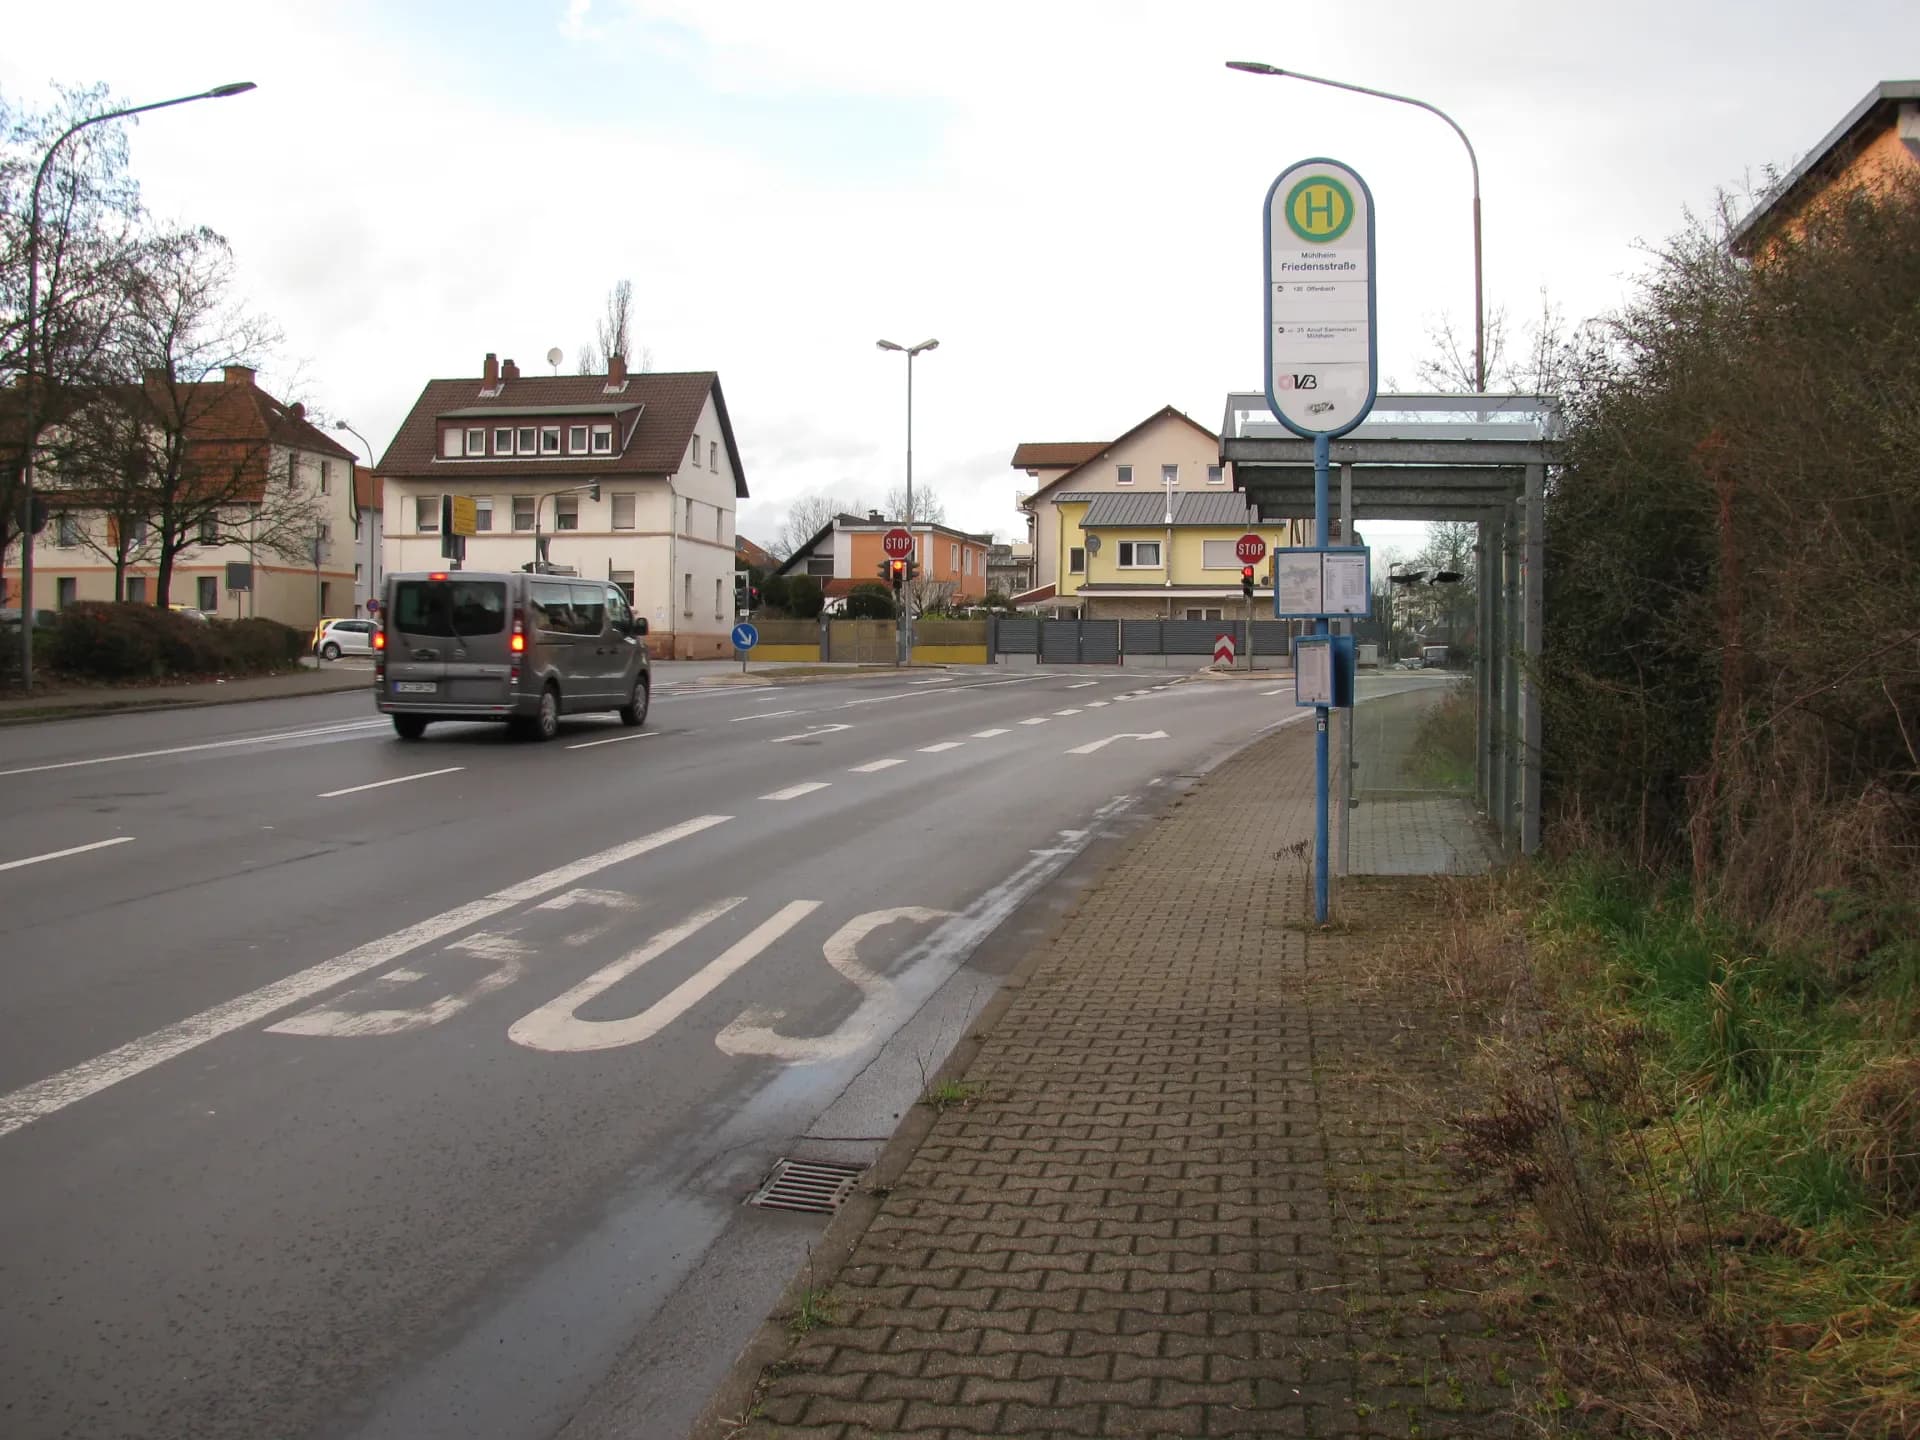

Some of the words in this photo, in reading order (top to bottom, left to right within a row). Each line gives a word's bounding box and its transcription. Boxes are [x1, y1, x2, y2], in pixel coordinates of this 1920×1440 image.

[1305, 191, 1333, 228] H
[1281, 261, 1357, 271] Friedensstraße
[885, 537, 910, 549] STOP
[1238, 543, 1264, 555] STOP
[263, 887, 962, 1058] BUS
